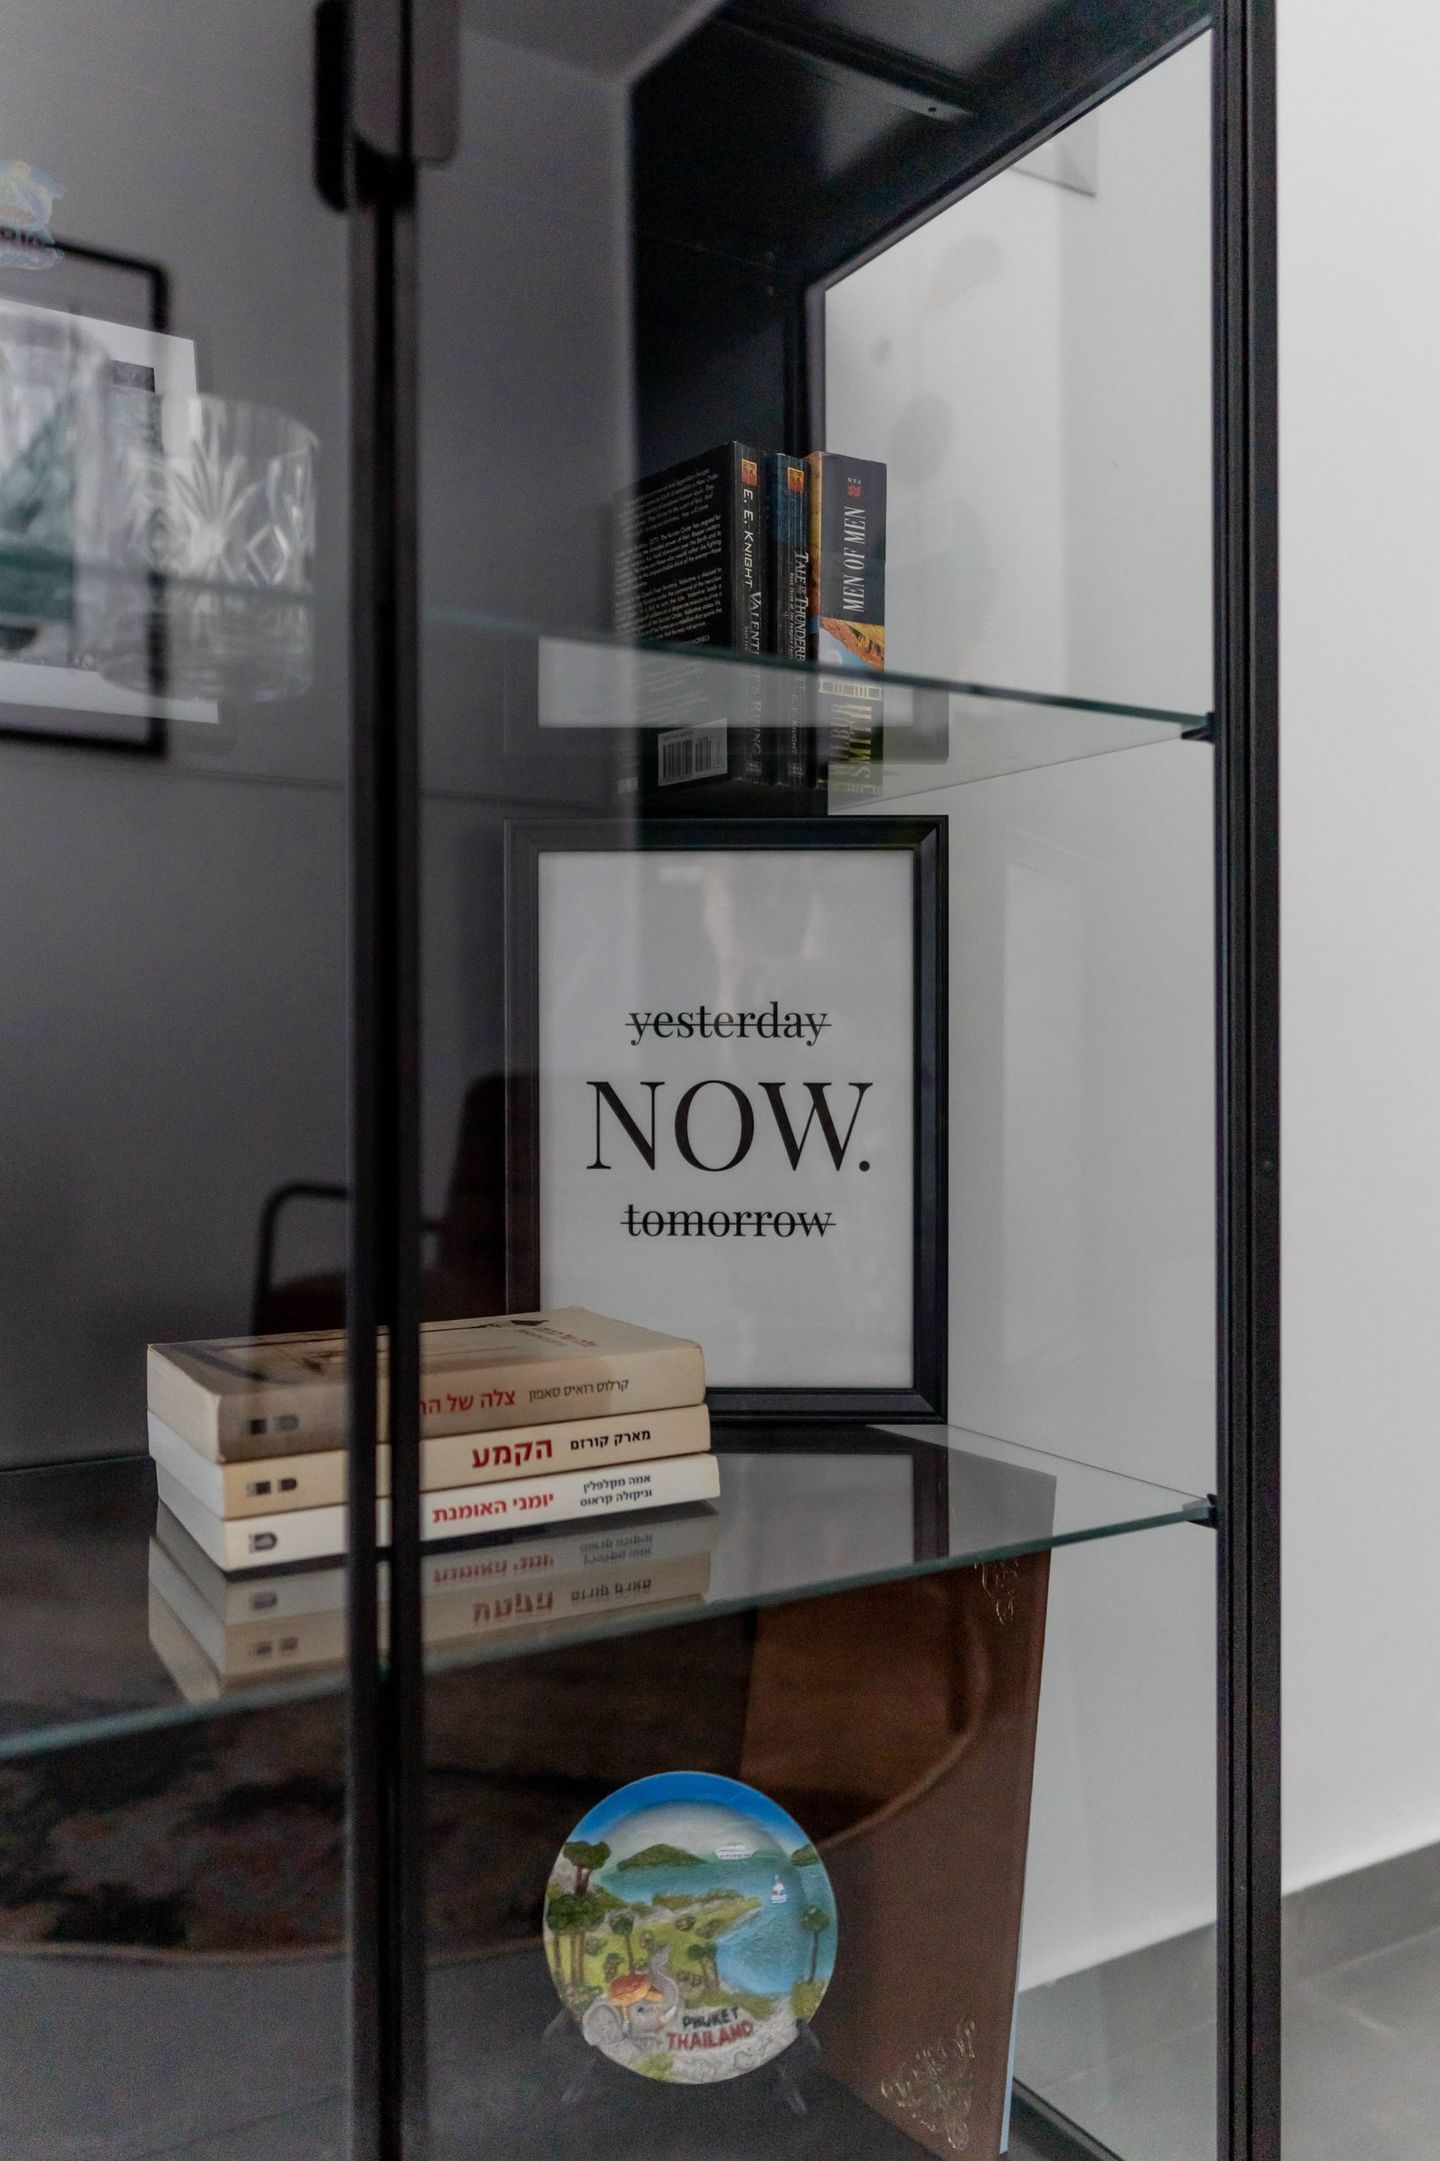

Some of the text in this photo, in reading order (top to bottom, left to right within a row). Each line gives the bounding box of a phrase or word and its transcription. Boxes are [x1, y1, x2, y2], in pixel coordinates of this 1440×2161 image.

[743, 488, 755, 588] E. E. KNIGHT
[795, 550, 809, 584] TALE
[842, 505, 866, 613] MEN OF MEN
[830, 703, 849, 776] WILBUR
[847, 703, 872, 778] SMITH
[627, 1001, 830, 1046] yesterday
[586, 1080, 873, 1172] NOW.
[623, 1204, 834, 1237] tomorrow
[418, 1388, 516, 1415] צלה של הר
[528, 1378, 630, 1403] קרלוס רואיס סאפון
[471, 1439, 553, 1468] הקמע
[570, 1429, 651, 1451] מארק קורזם
[579, 1489, 653, 1507] וניקולה קראוס
[583, 1474, 651, 1494] אמה מקלפלין
[432, 1492, 555, 1523] יומני האומנת
[681, 2005, 739, 2029] PHUKET
[666, 2019, 754, 2051] THAILAND
